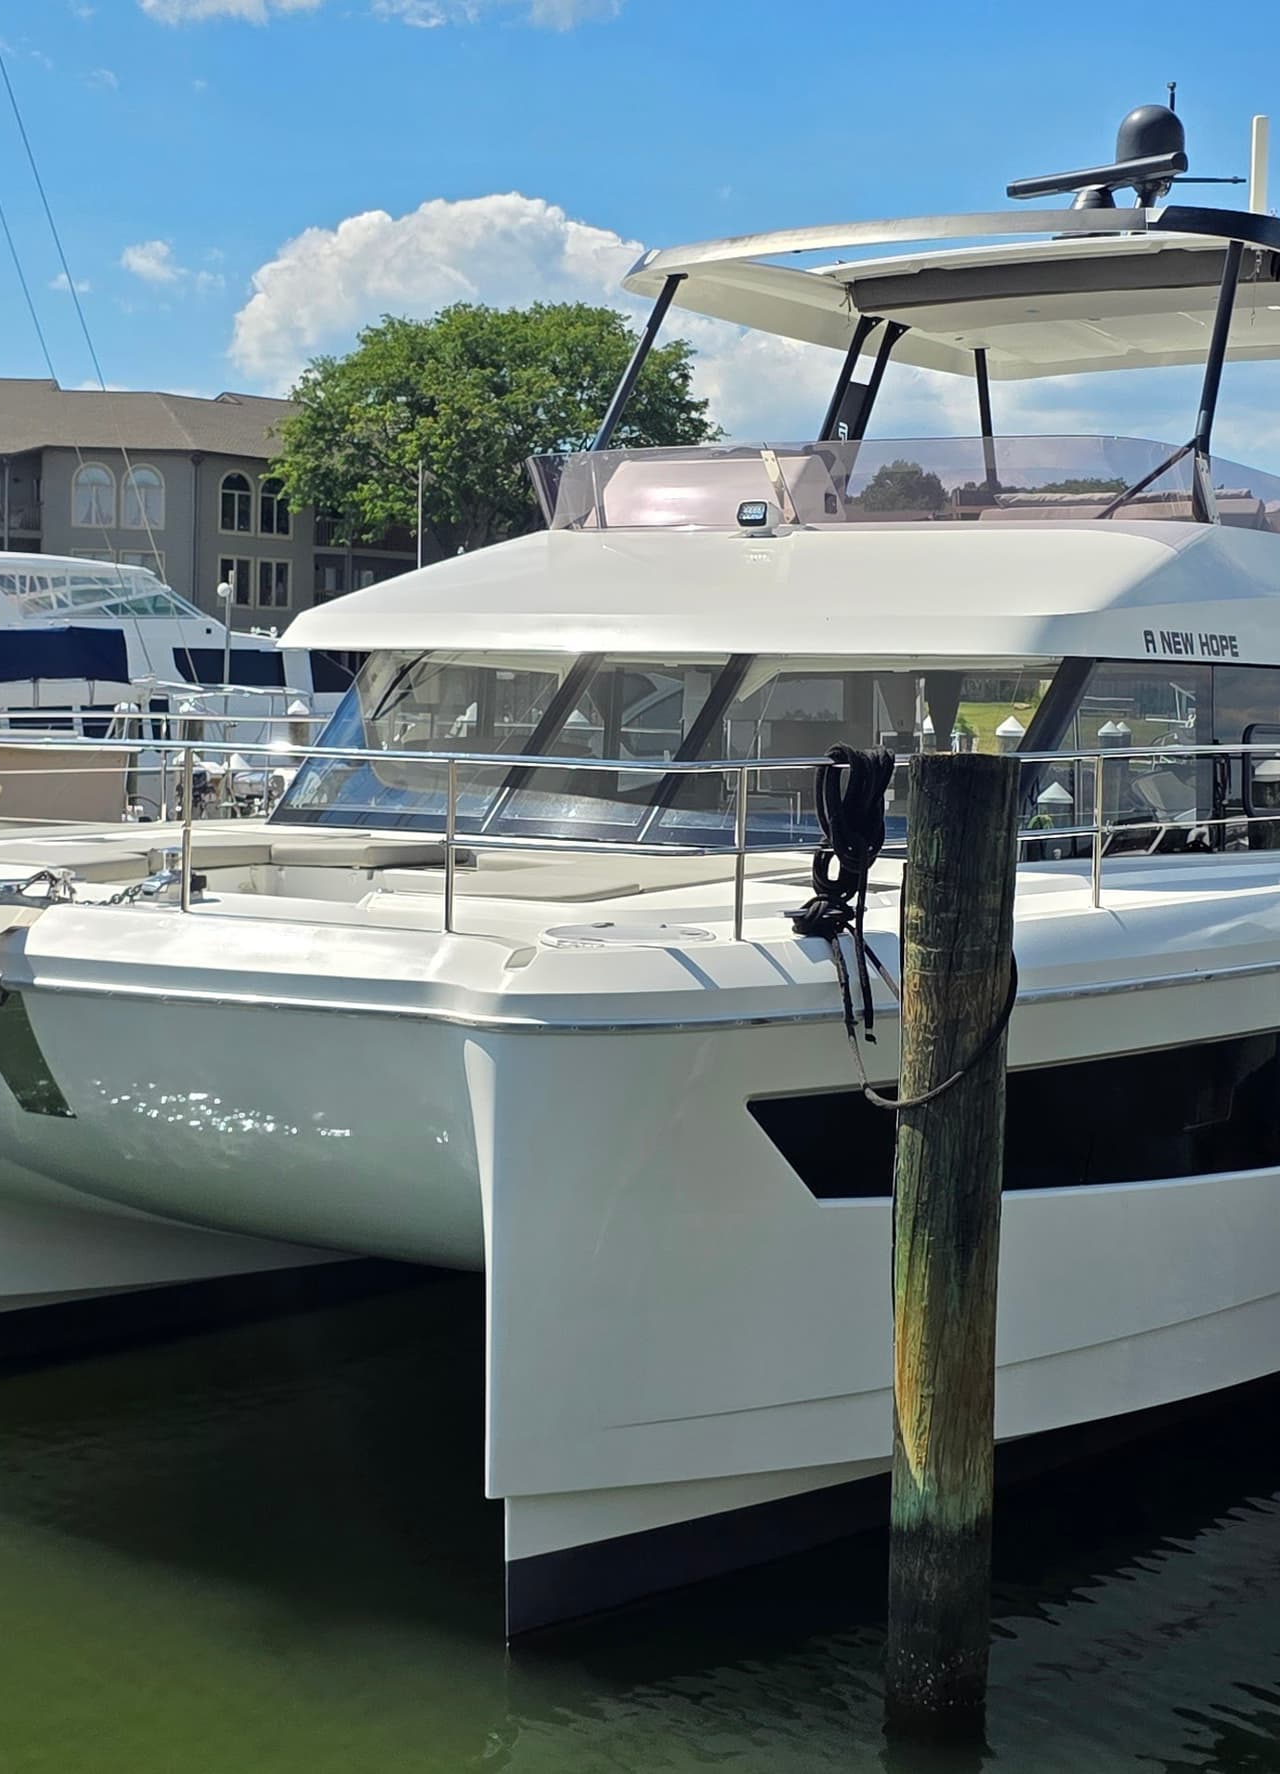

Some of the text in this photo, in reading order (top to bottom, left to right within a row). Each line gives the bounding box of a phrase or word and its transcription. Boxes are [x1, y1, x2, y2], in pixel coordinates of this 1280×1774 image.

[1143, 630, 1240, 657] A NEW HOPE
